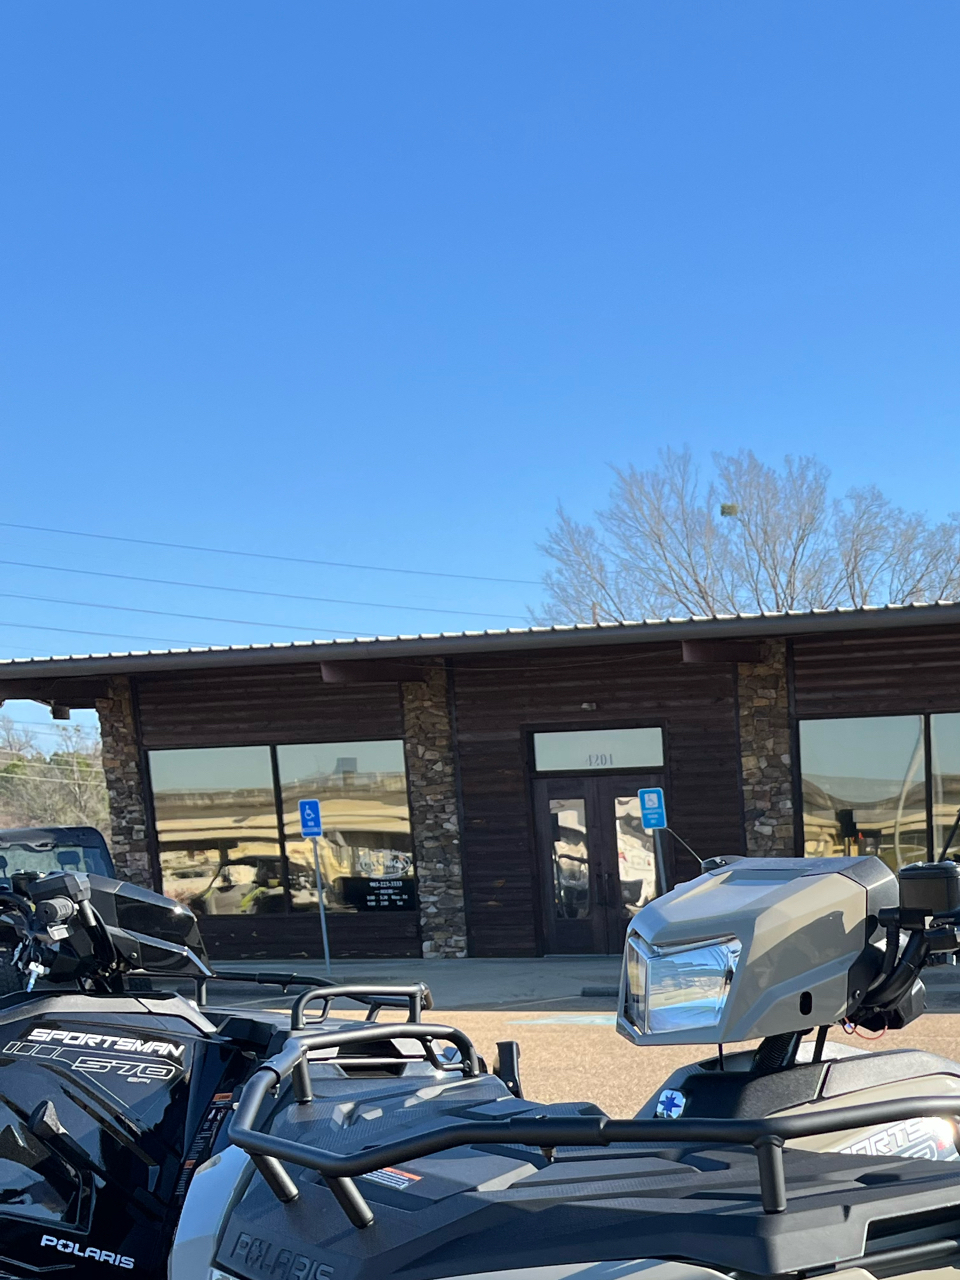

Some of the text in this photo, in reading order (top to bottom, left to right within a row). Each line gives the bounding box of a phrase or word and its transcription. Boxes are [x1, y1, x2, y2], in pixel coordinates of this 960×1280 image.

[28, 1029, 185, 1057] SPORTSMAN
[71, 1057, 176, 1079] 570
[40, 1234, 135, 1270] POLARIS
